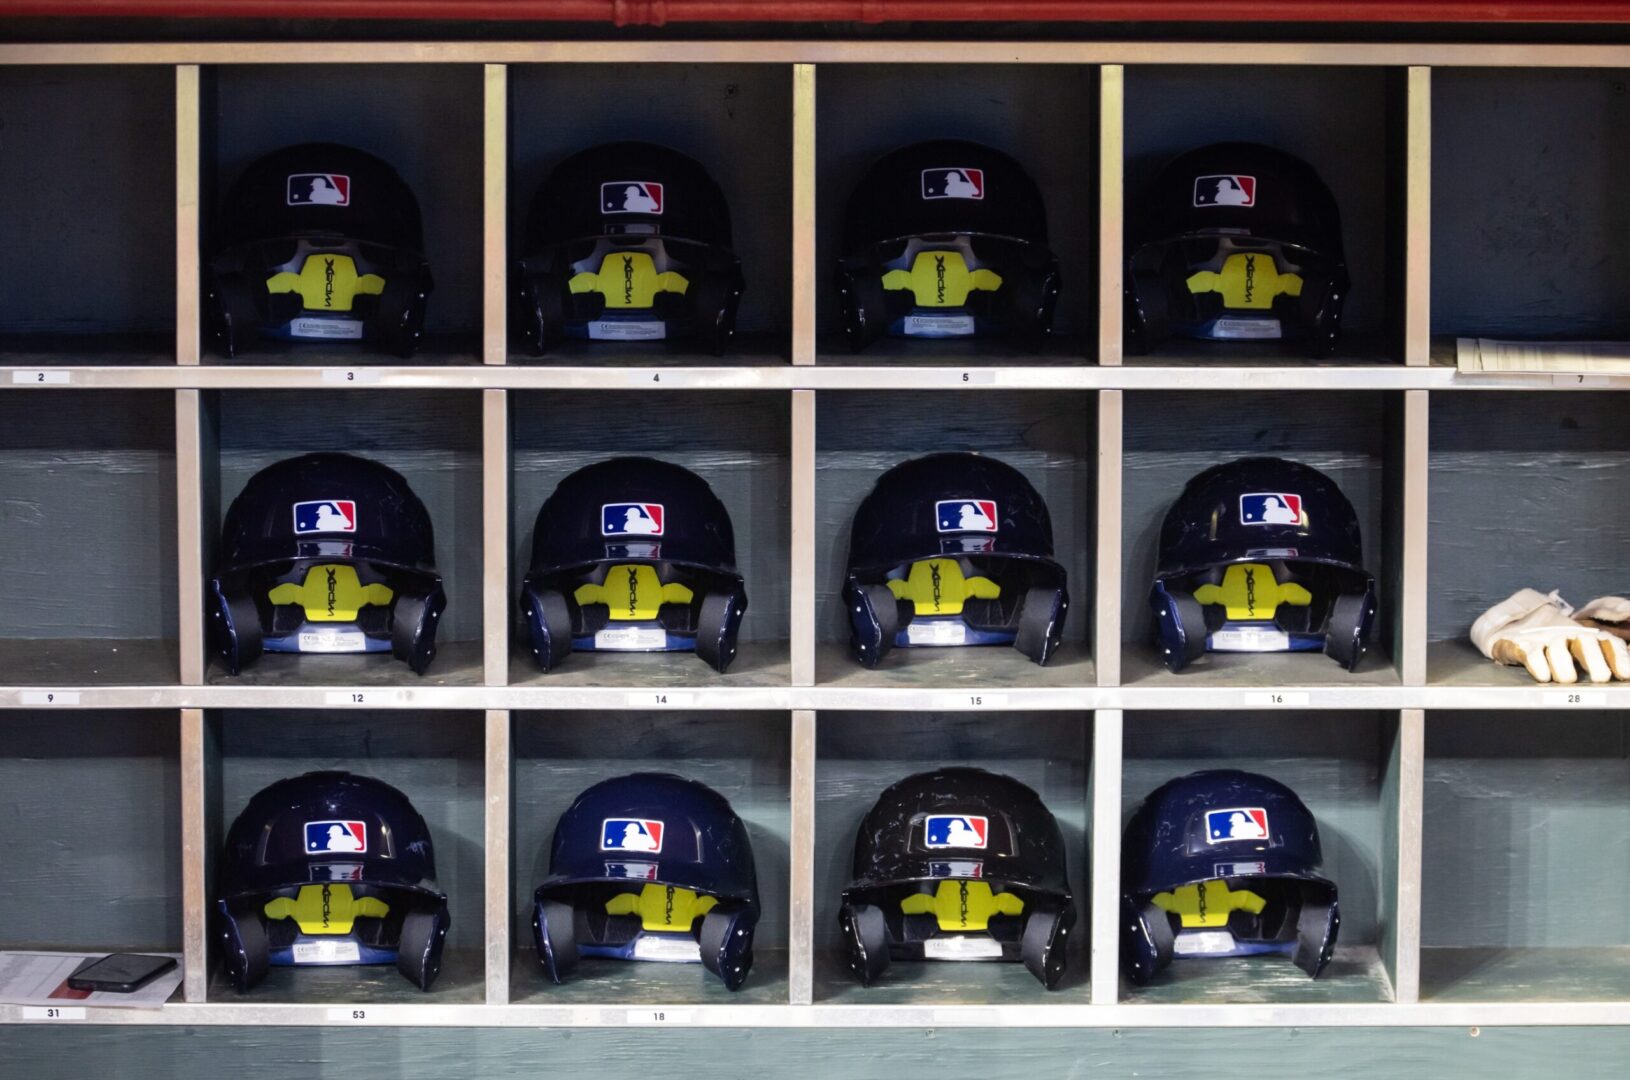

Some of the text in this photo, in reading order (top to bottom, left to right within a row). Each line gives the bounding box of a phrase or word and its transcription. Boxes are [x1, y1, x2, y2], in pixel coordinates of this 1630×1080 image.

[38, 372, 45, 382] 2
[347, 372, 354, 382] 3
[652, 373, 660, 383] 4
[962, 373, 969, 382] 5
[1577, 374, 1585, 384] 7
[47, 693, 54, 703] 9
[352, 694, 364, 703] 12
[655, 695, 667, 704] 14
[969, 696, 982, 706] 15
[1271, 694, 1283, 704] 16
[1568, 694, 1581, 703] 28
[47, 1008, 60, 1018] 31
[352, 1010, 366, 1019] 53
[654, 1012, 665, 1021] 18
